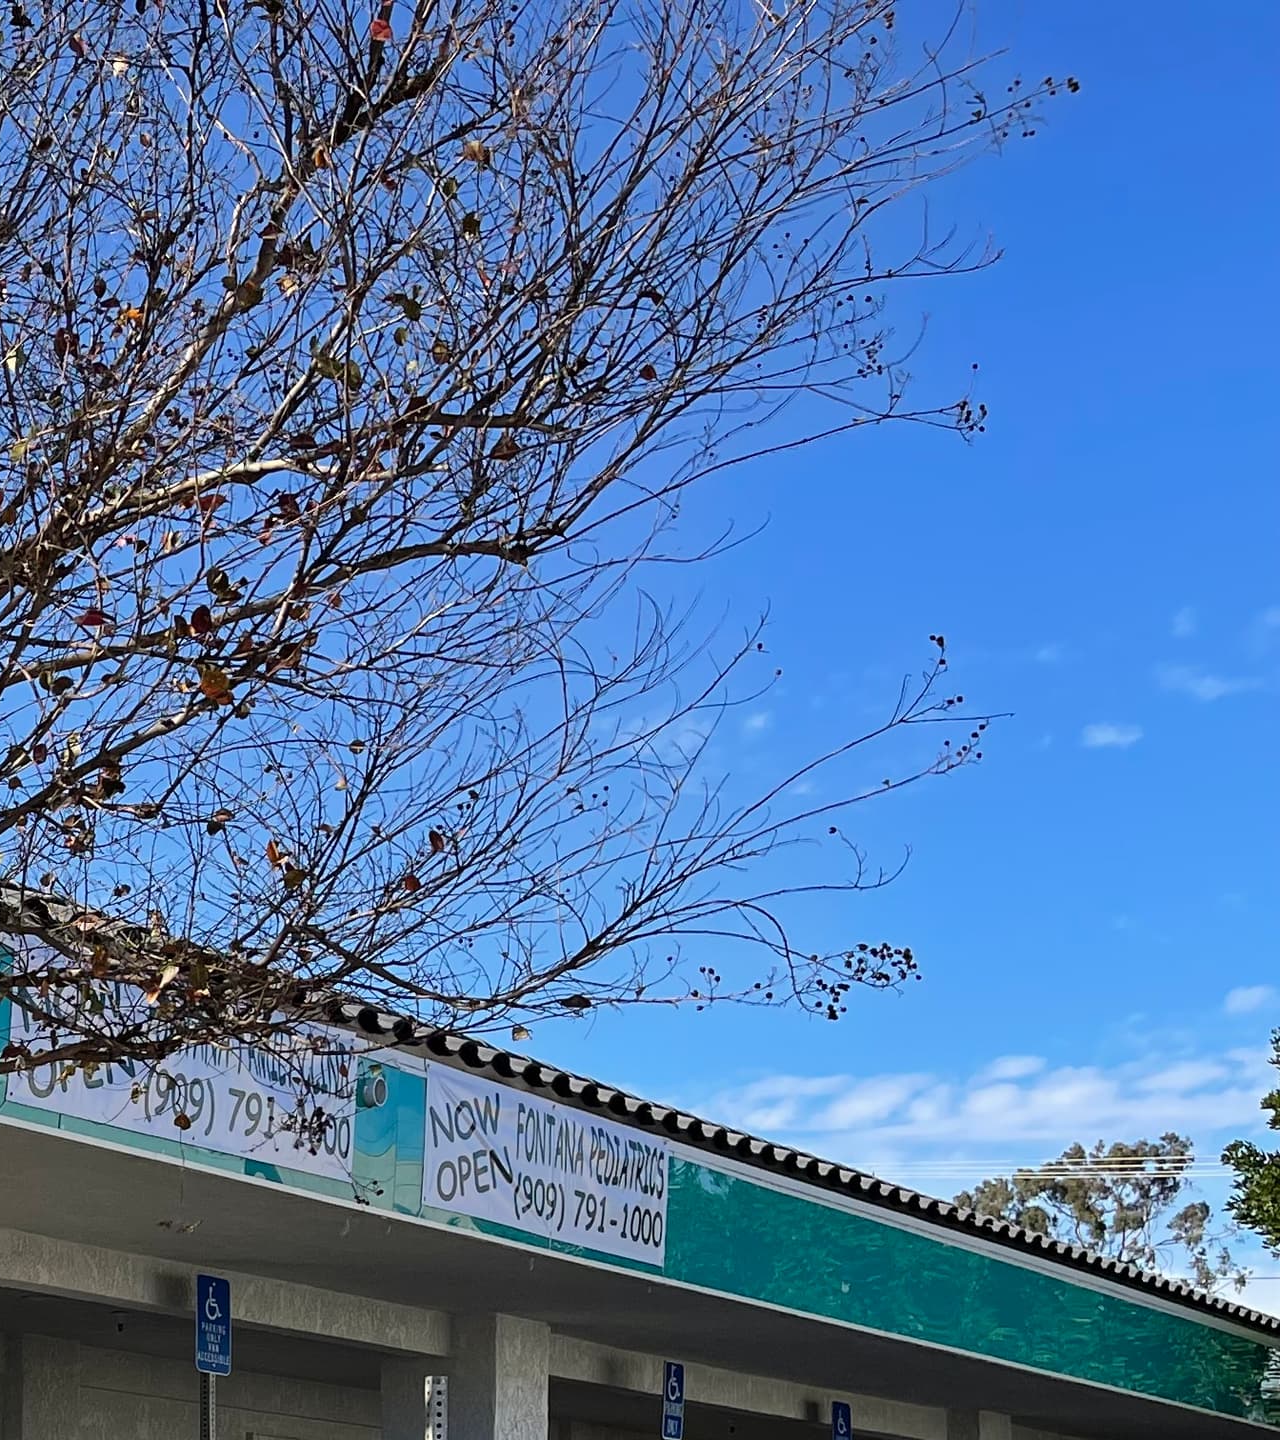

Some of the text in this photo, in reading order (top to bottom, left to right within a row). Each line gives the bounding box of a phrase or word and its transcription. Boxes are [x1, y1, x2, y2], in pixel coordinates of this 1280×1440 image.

[28, 1043, 136, 1099] ON
[144, 1064, 351, 1160] (909) 79100
[429, 1092, 500, 1148] NOW
[436, 1145, 513, 1202] OPEN
[516, 1102, 665, 1200] FONTANA PEDIATRICS
[513, 1171, 664, 1248] (909) 791-1000
